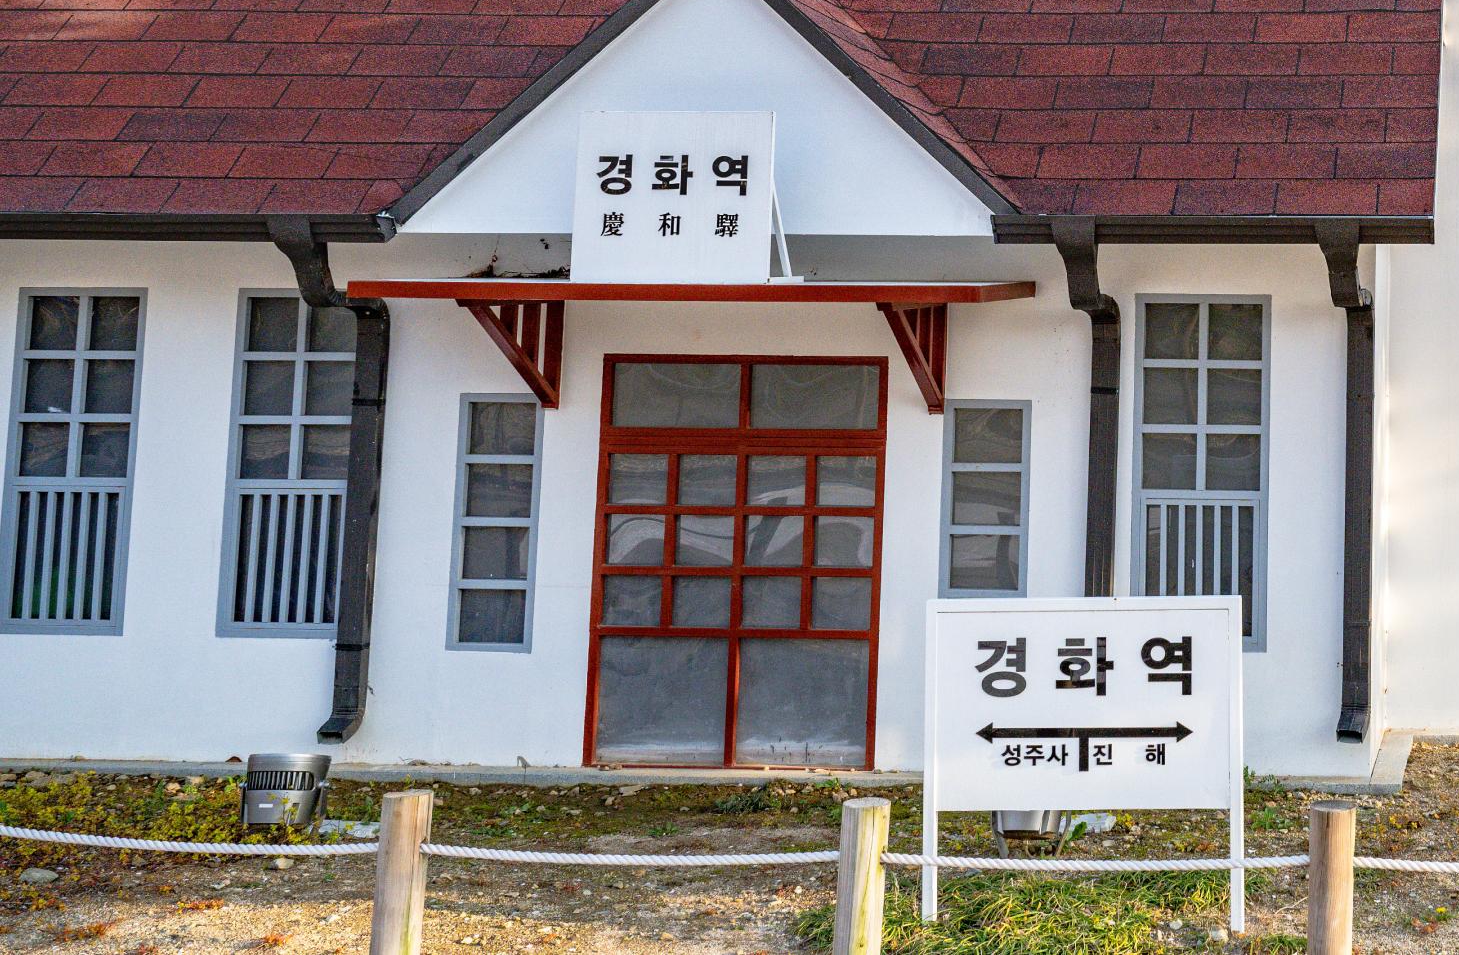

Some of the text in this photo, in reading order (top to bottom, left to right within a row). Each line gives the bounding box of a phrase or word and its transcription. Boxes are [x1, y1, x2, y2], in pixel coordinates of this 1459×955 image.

[596, 154, 749, 196] 경화역
[600, 212, 739, 237] 慶和驛
[974, 636, 1193, 698] 경화역
[1001, 743, 1167, 767] 성주사 진해
